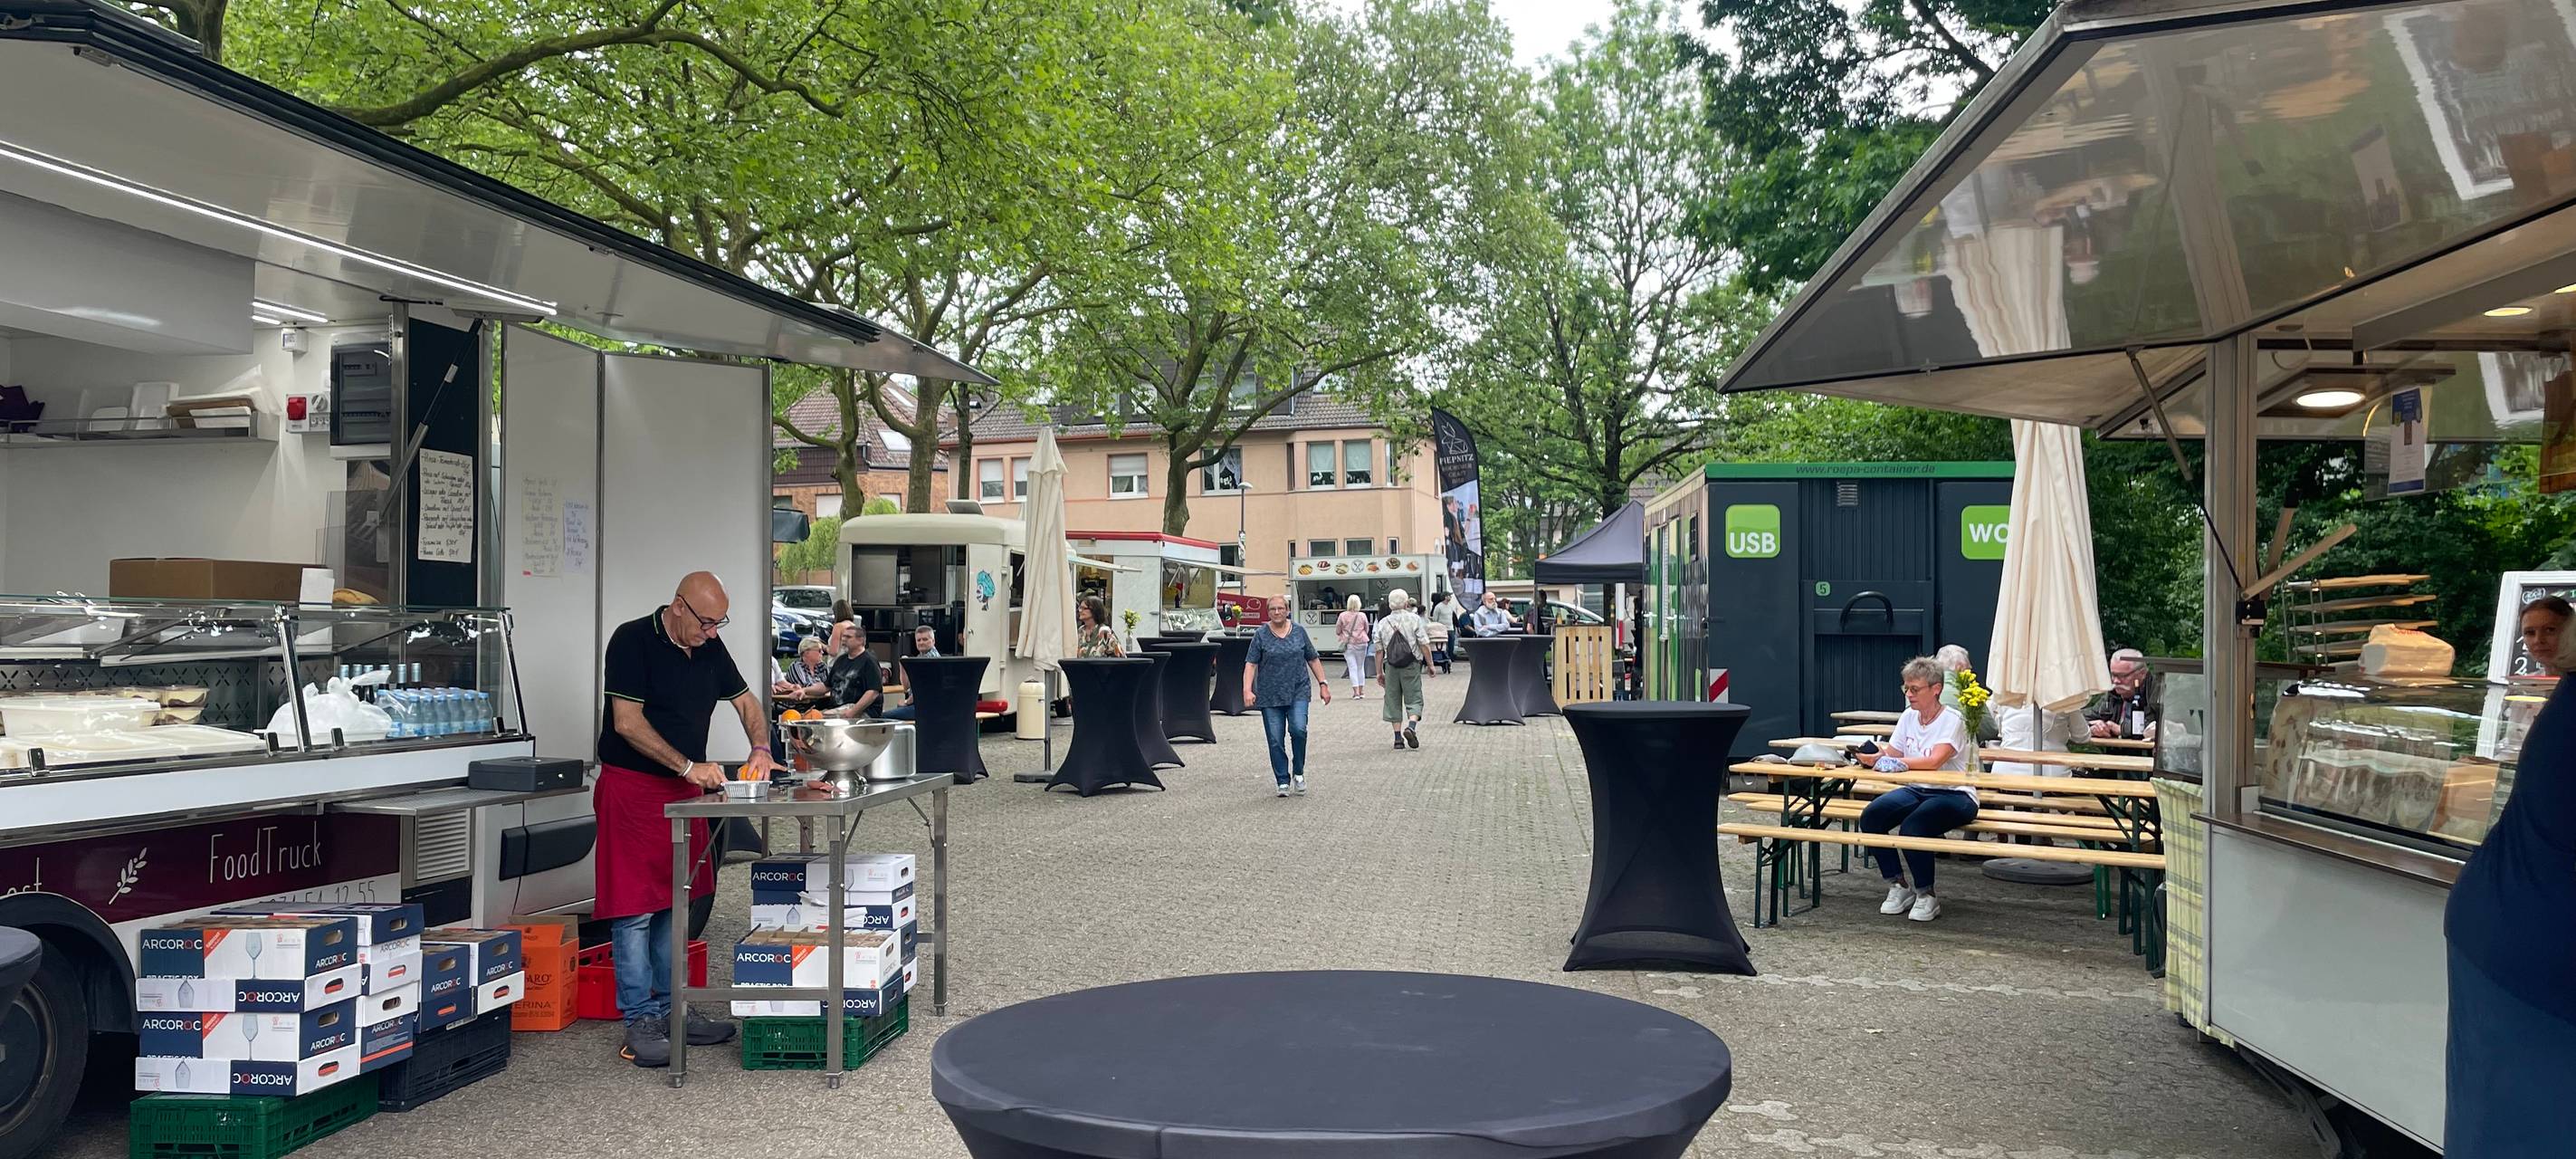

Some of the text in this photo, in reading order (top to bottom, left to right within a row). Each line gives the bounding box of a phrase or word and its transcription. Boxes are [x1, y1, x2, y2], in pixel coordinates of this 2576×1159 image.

[1730, 532, 1777, 553] USB
[1818, 583, 1827, 594] 5
[752, 872, 804, 882] ARCOROC
[142, 939, 203, 950] ARCOROC
[379, 938, 410, 953] ARCOROC
[315, 953, 348, 969] ARCOROC
[736, 953, 791, 963] ARCOROC
[431, 977, 462, 992] ARCOROC
[238, 991, 301, 1003] ARCOROC
[143, 1020, 201, 1031] ARCOROC
[310, 1032, 346, 1051] ARCOROC
[233, 1072, 293, 1086] ARCOROC
